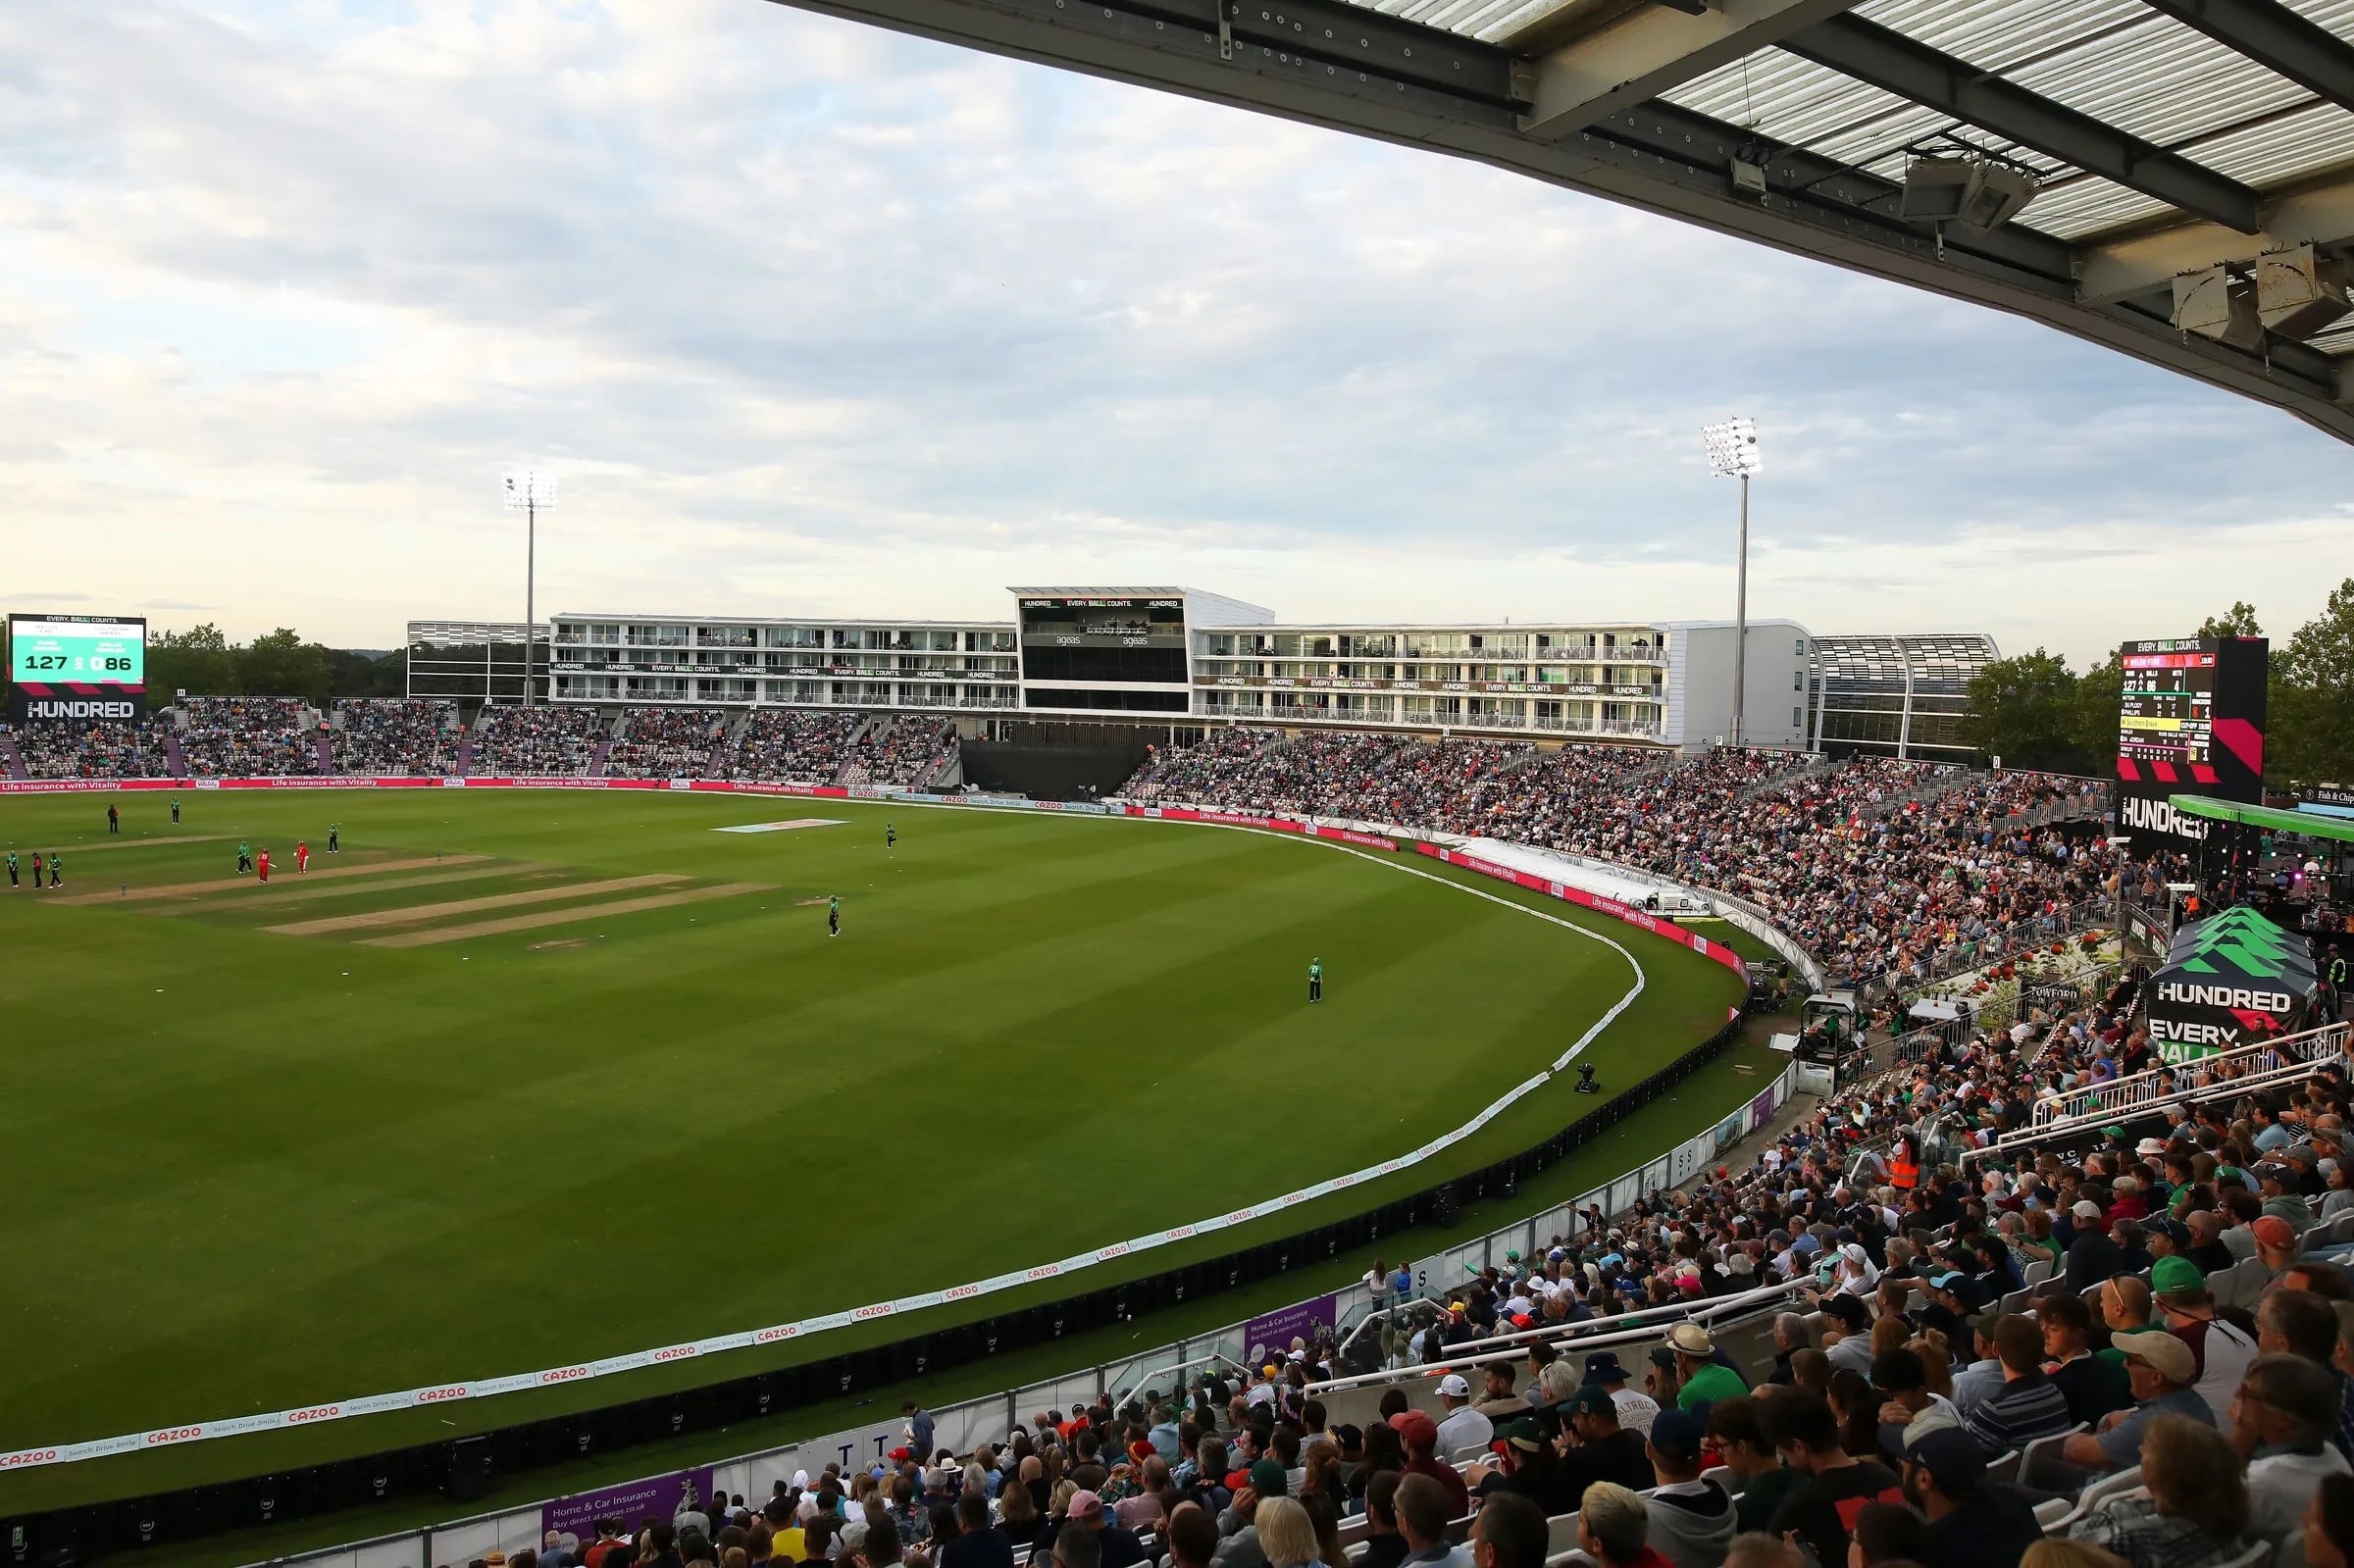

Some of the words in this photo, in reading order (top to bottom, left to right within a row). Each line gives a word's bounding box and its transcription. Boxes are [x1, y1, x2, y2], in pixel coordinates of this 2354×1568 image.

[1056, 636, 1081, 646] ageas
[1123, 637, 1148, 647] ageas
[2138, 642, 2157, 652] EVERY.
[2175, 640, 2201, 650] COUNTS.
[26, 656, 68, 669] 127
[2123, 681, 2136, 691] 127
[2174, 680, 2179, 692] 4
[28, 701, 133, 718] HUNDRED
[2205, 706, 2211, 719] 1
[2203, 749, 2209, 761] 1
[89, 782, 122, 790] Vitality
[2318, 790, 2330, 800] Fish
[1253, 817, 1269, 827] Vitality
[1592, 895, 1602, 906] Life
[1602, 900, 1624, 914] insuranc
[1624, 910, 1637, 922] with
[1638, 913, 1656, 932] Vitality
[2158, 982, 2291, 1013] HUNDRED
[2149, 1019, 2240, 1047] EVERY.
[1283, 1192, 1305, 1204] CAZOO
[1229, 1210, 1253, 1222] CAZOO
[1166, 1228, 1193, 1239] CAZOO
[1100, 1245, 1126, 1258] CAZOO
[1027, 1266, 1058, 1279] CAZOO
[946, 1285, 979, 1299] CAZOO
[855, 1304, 891, 1318] CAZOO
[1251, 1324, 1267, 1333] Home
[1284, 1310, 1308, 1322] Insurance
[758, 1327, 796, 1340] CAZOO
[654, 1346, 695, 1360] CAZOO
[542, 1367, 587, 1382] CAZOO
[419, 1388, 466, 1401] CAZOO
[288, 1406, 339, 1422] CAZOO
[1617, 1400, 1657, 1417] ALTROCK
[148, 1427, 201, 1443] CAZOO
[873, 1435, 889, 1457] T
[0, 1450, 56, 1466] CAZOO
[838, 1443, 853, 1466] T
[553, 1505, 582, 1518] Home
[584, 1502, 592, 1511] &
[594, 1499, 610, 1509] Car
[613, 1489, 657, 1505] Insurance
[553, 1521, 567, 1530] Buy
[569, 1516, 591, 1526] direct
[592, 1512, 601, 1521] at
[602, 1503, 645, 1520] ageas.co.uk
